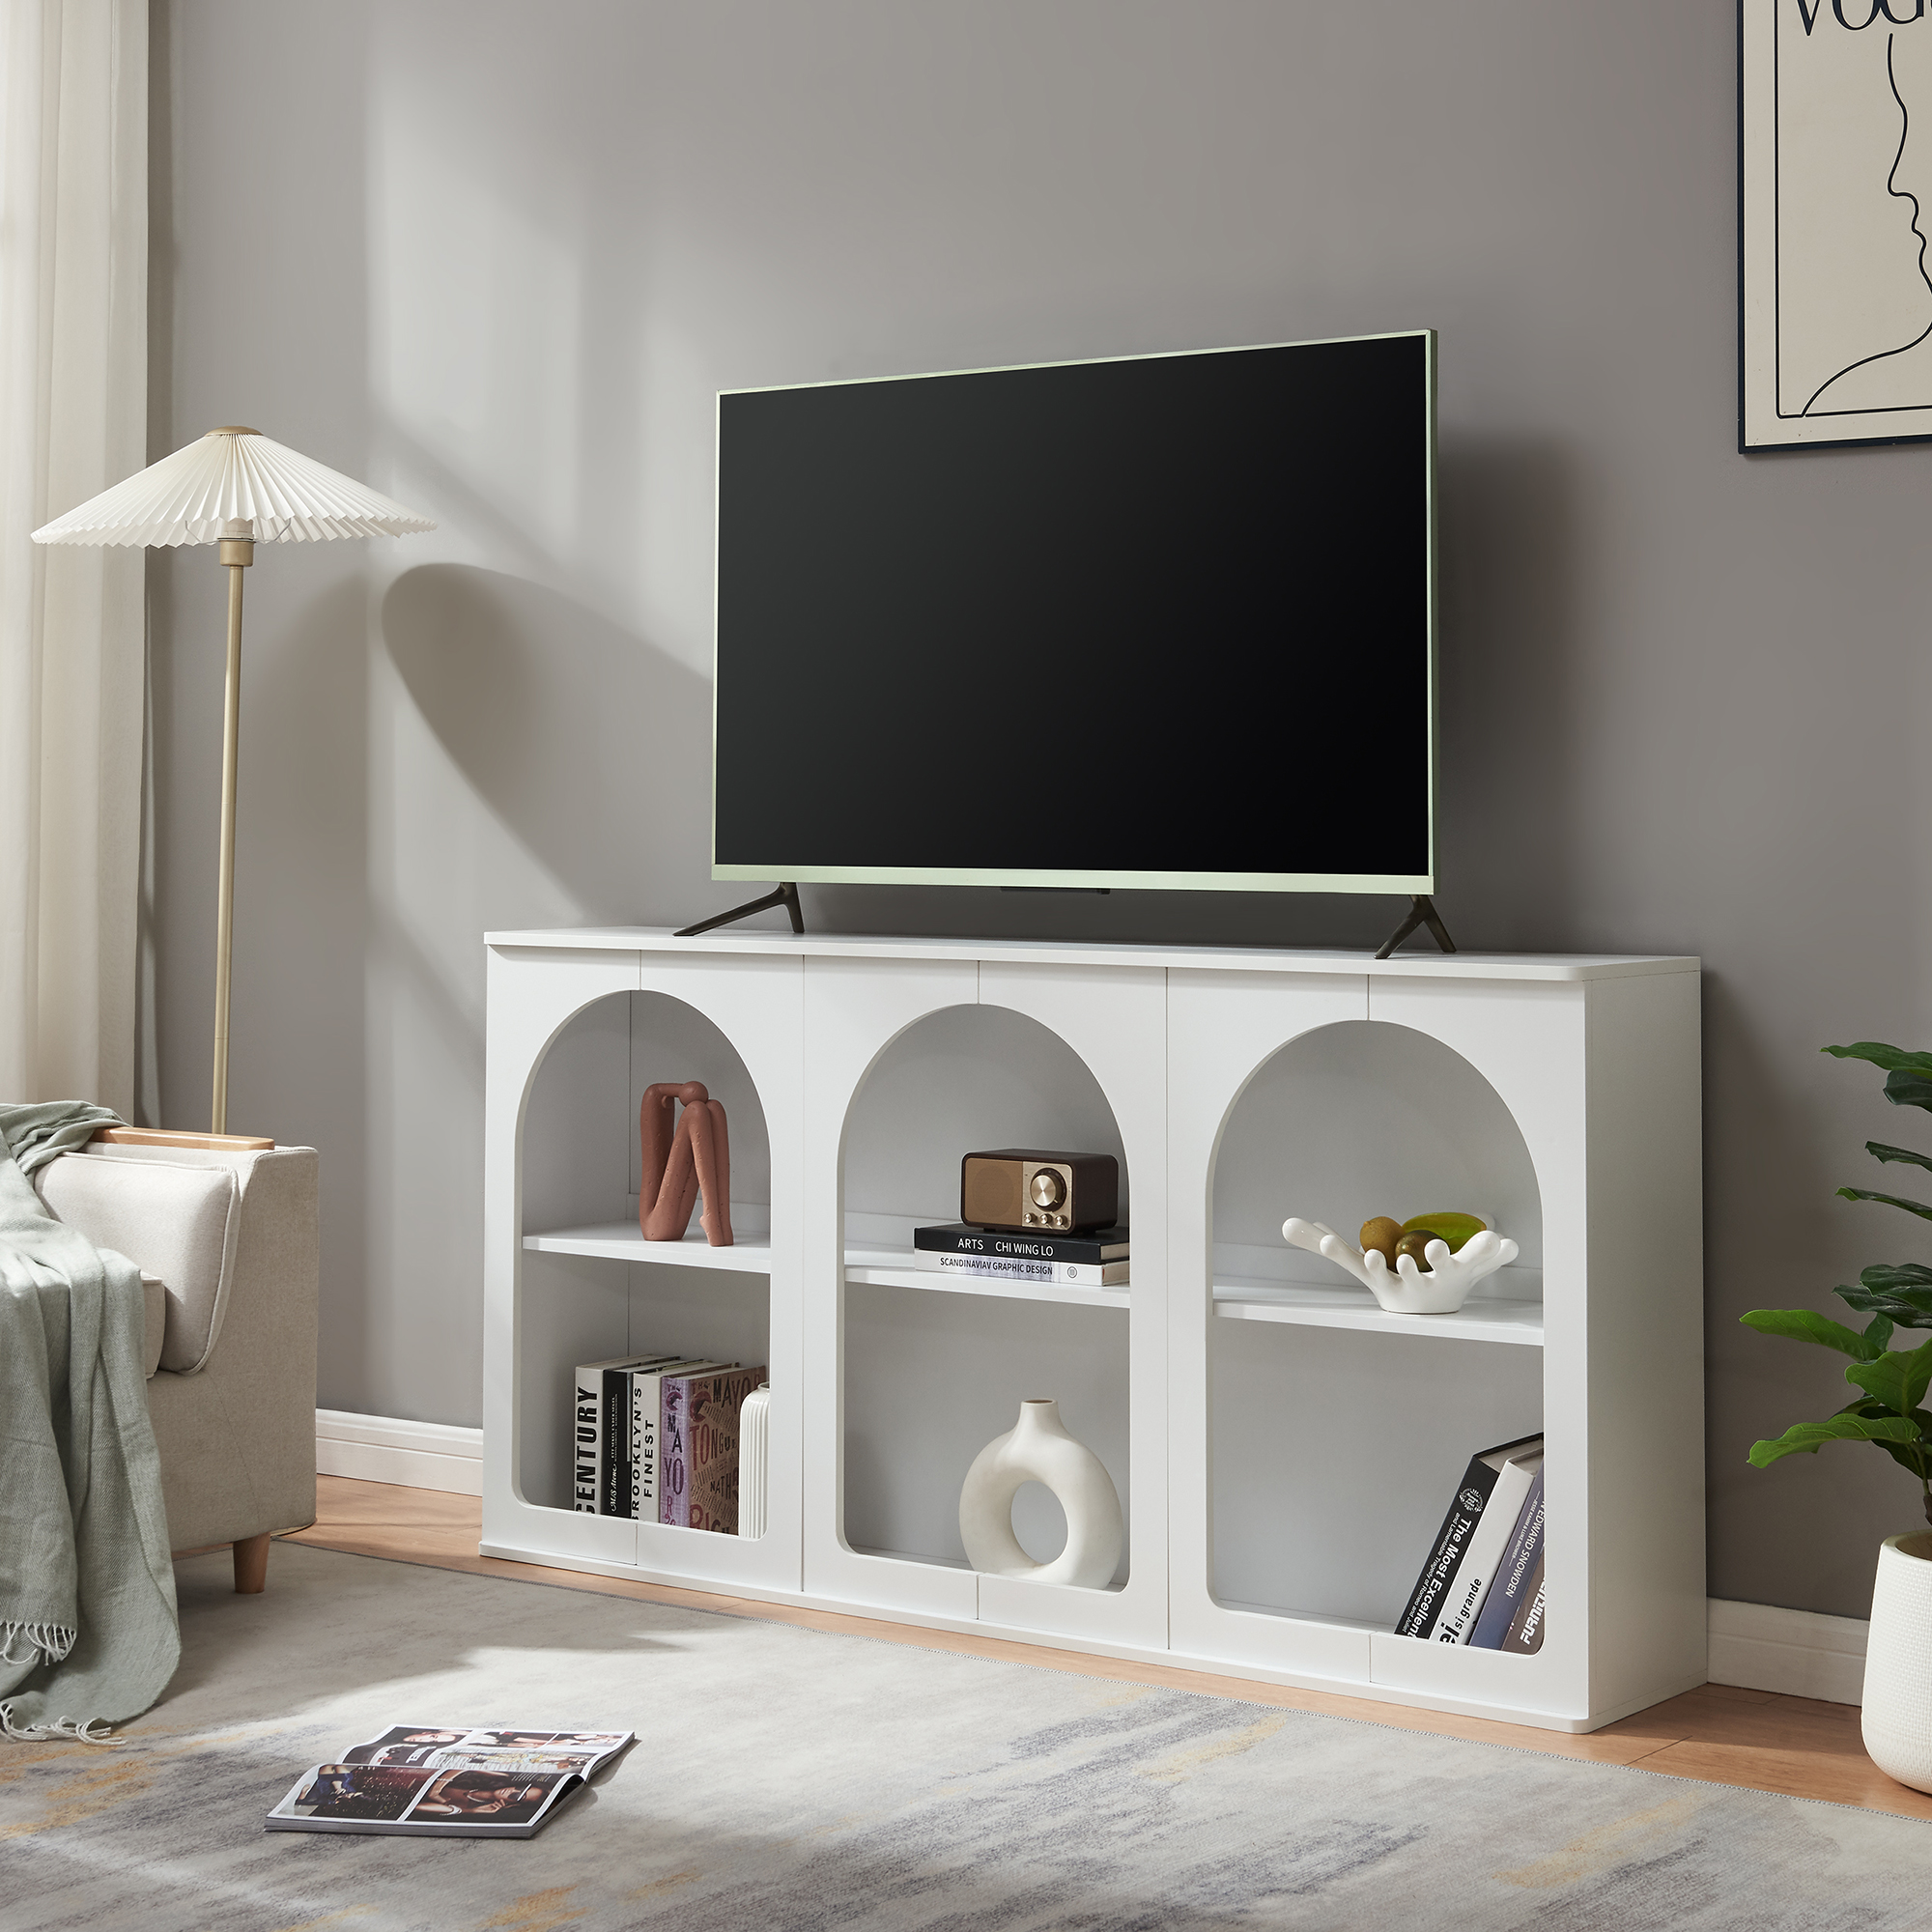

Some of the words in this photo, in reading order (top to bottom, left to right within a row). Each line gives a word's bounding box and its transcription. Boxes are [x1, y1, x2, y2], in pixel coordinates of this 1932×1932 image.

[957, 1237, 984, 1251] ARTS
[995, 1241, 1011, 1253] CHI
[1013, 1242, 1039, 1256] WING
[1041, 1245, 1054, 1257] LO
[992, 1262, 1025, 1273] GRAPHIC
[1026, 1264, 1053, 1275] DESIGN
[643, 1419, 654, 1498] FINEST
[1452, 1512, 1461, 1525] and
[1452, 1518, 1472, 1543] The
[1524, 1508, 1546, 1550] EDWARD
[1437, 1522, 1457, 1556] Lamentable
[1426, 1555, 1441, 1579] Tragedy
[1435, 1543, 1460, 1578] Most
[1423, 1578, 1430, 1587] of
[1505, 1548, 1530, 1599] SNOWDEN
[1413, 1585, 1428, 1605] Romeo
[1454, 1615, 1465, 1630] si
[1460, 1577, 1482, 1619] grande
[1408, 1605, 1417, 1618] and
